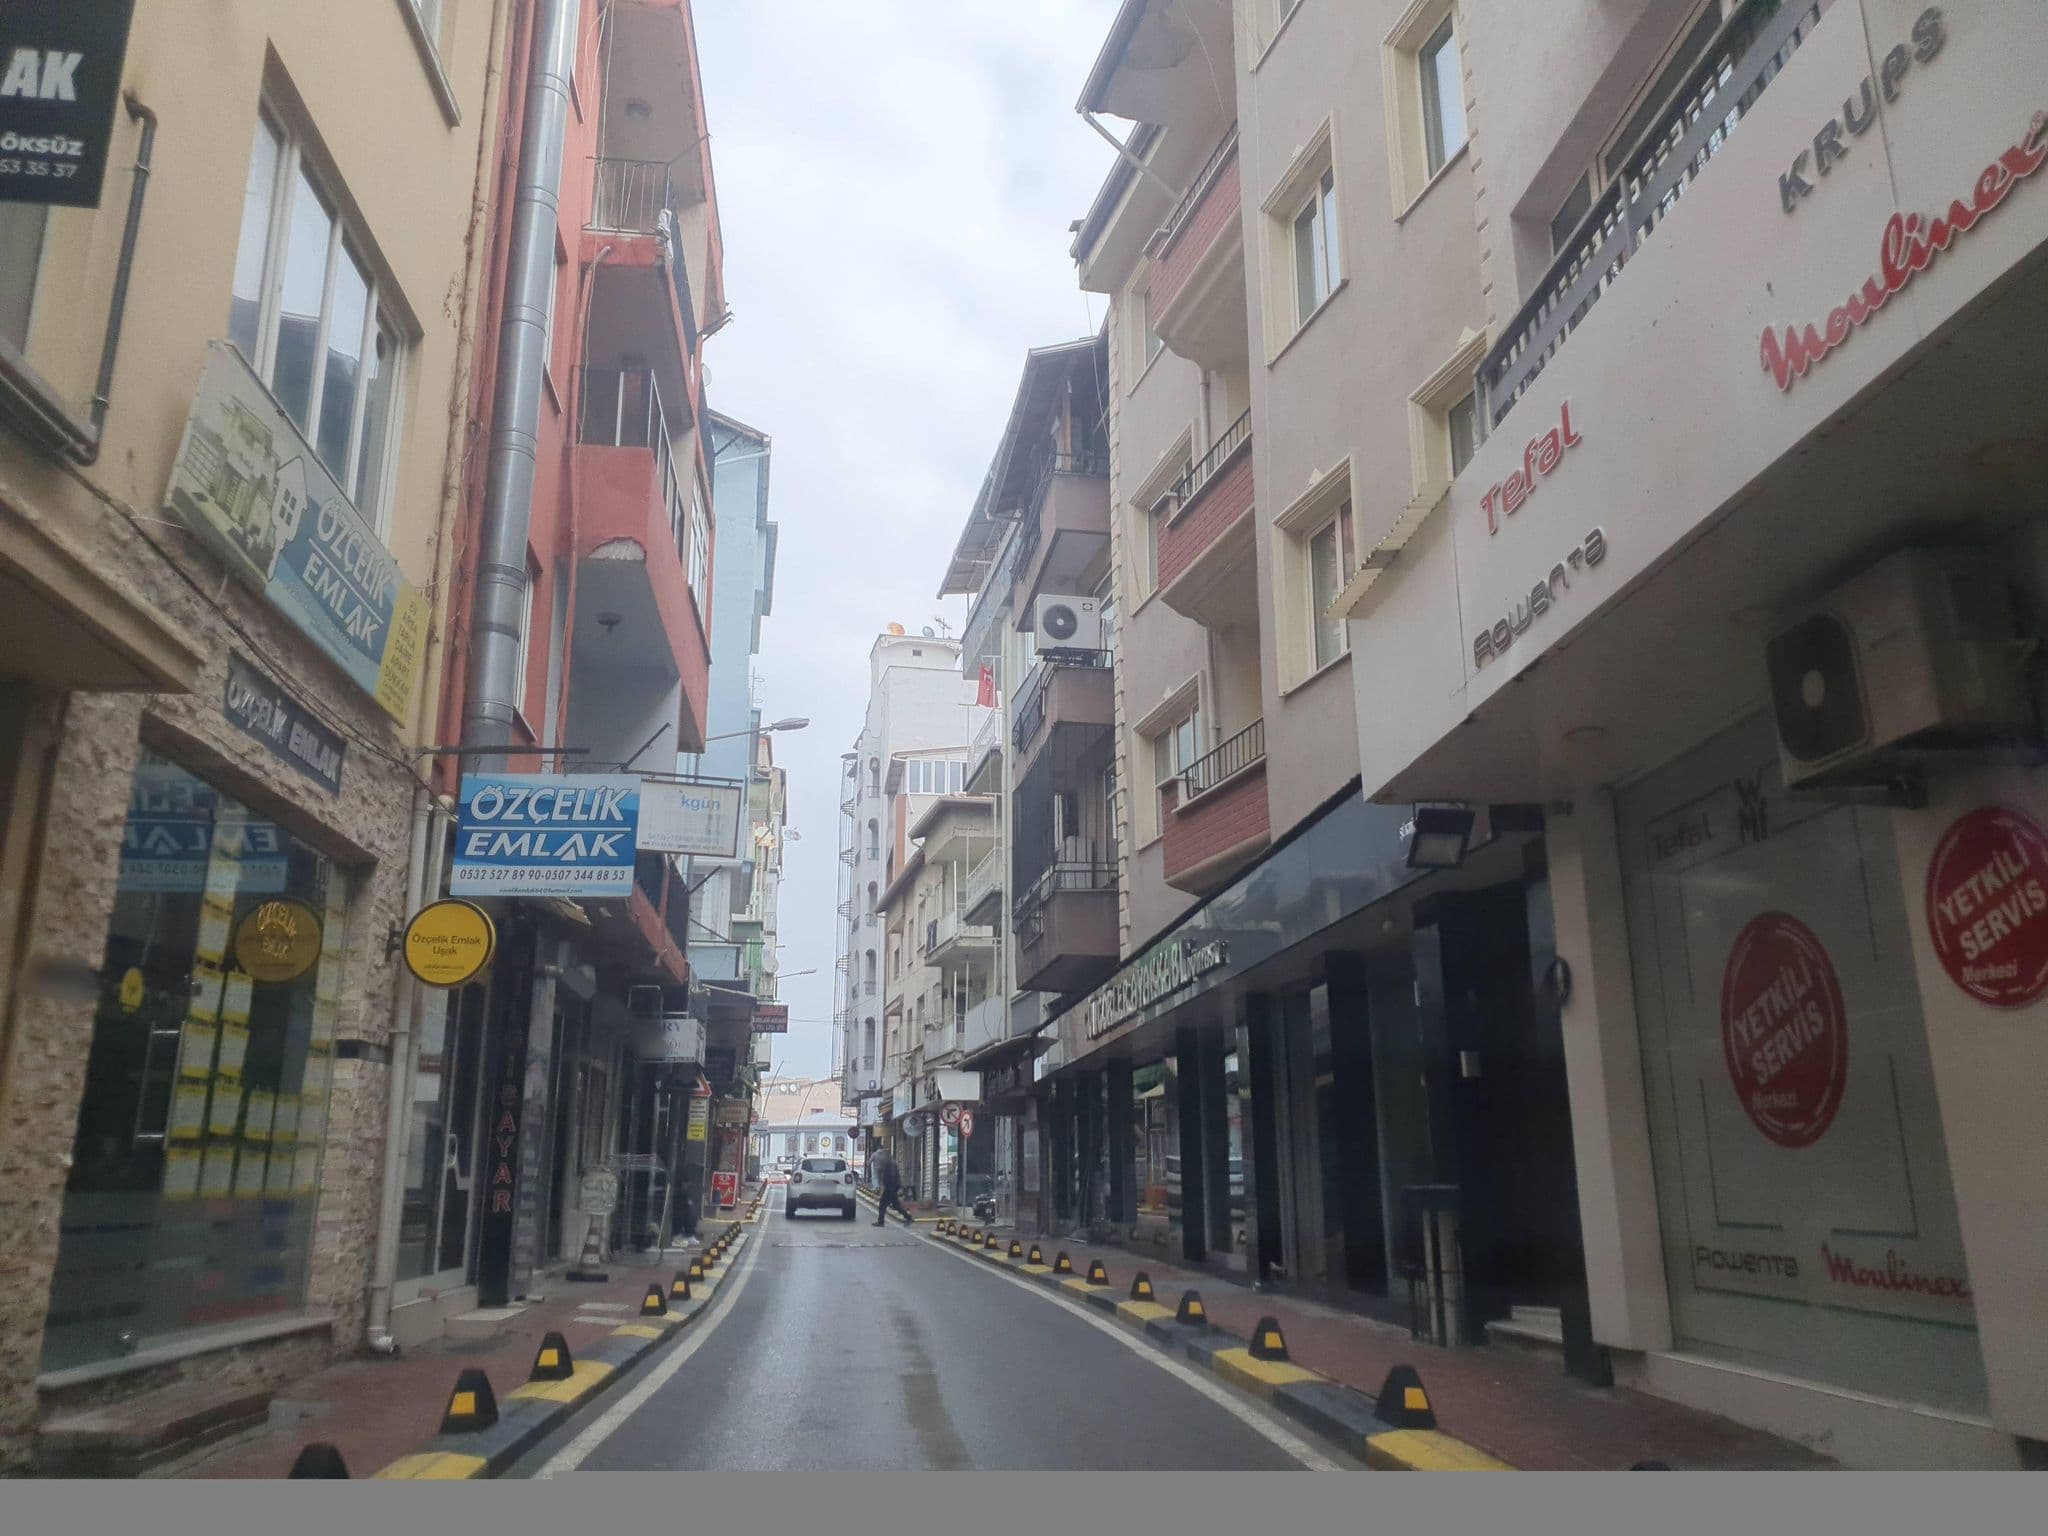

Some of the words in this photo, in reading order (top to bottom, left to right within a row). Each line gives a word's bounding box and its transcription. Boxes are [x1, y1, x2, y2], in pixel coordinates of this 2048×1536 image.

[1779, 7, 1946, 213] KRUPS
[1480, 401, 1582, 535] Tefal
[317, 499, 392, 608] ÖZÇELİK
[303, 552, 379, 649] EMLAK
[470, 785, 632, 825] ÖZÇELİK
[680, 792, 720, 811] kgün
[459, 869, 486, 881] 0532
[489, 869, 508, 881] 527
[511, 869, 525, 881] 89
[573, 869, 593, 881] 344
[596, 869, 609, 881] 88
[612, 869, 625, 881] 53
[464, 832, 626, 862] EMLAK
[1939, 831, 2031, 925] YETKİLİ
[1960, 879, 2046, 960] SERVİS
[1735, 953, 1813, 1049] YETKİLİ
[1752, 1000, 1824, 1086] SERVİS
